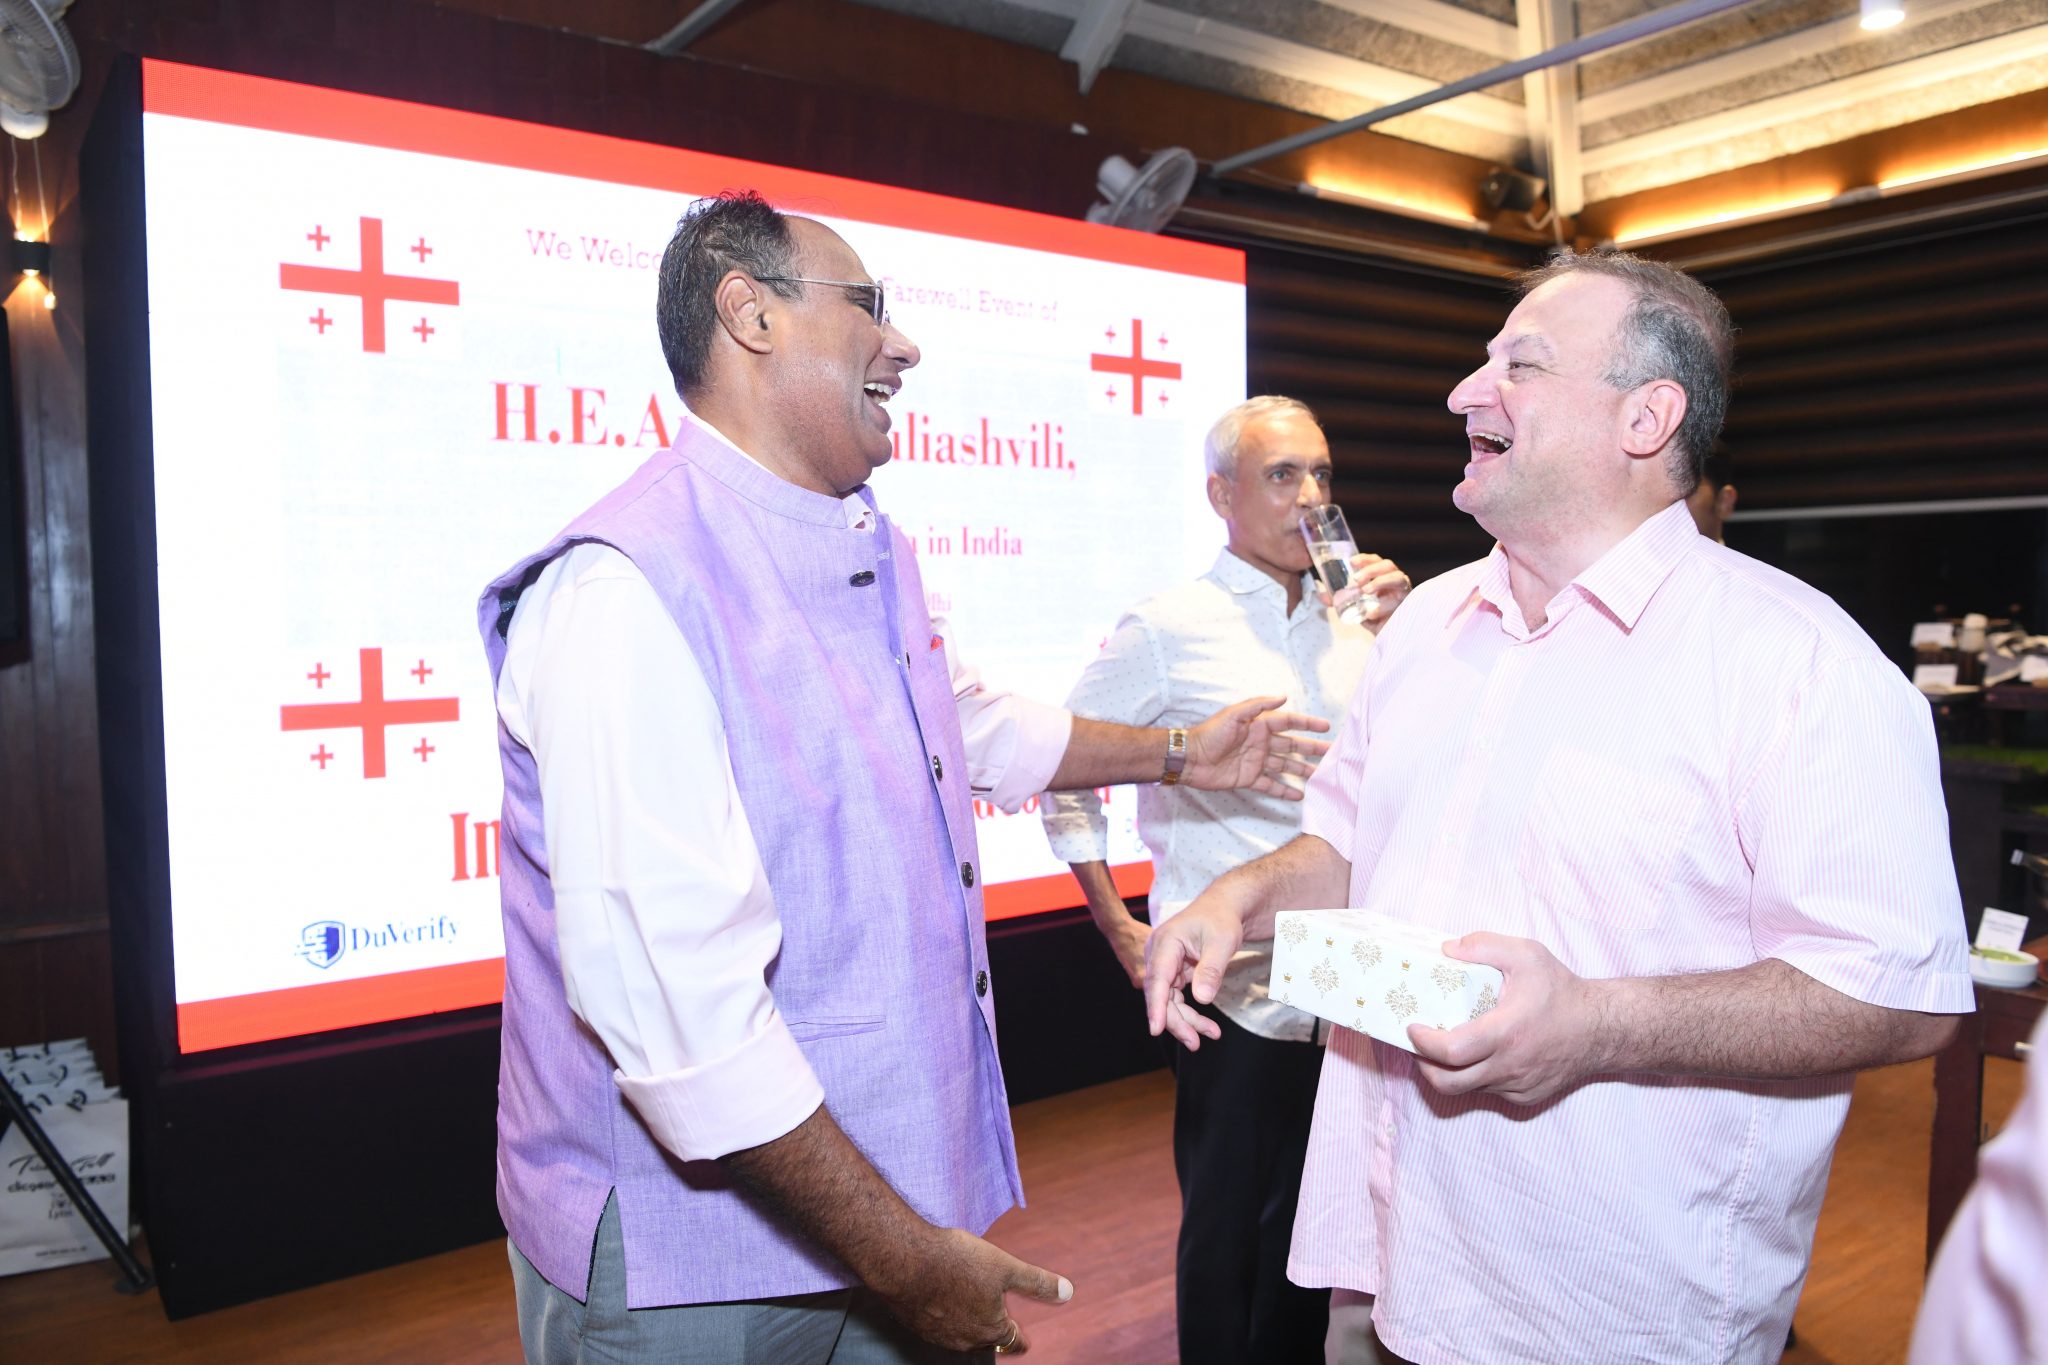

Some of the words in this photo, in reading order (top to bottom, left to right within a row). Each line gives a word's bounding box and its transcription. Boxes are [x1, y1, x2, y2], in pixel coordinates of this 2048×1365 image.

[526, 228, 572, 260] We
[978, 289, 1034, 318] Event
[928, 525, 952, 556] in
[962, 525, 1023, 556] India
[351, 914, 460, 951] DuVerify
